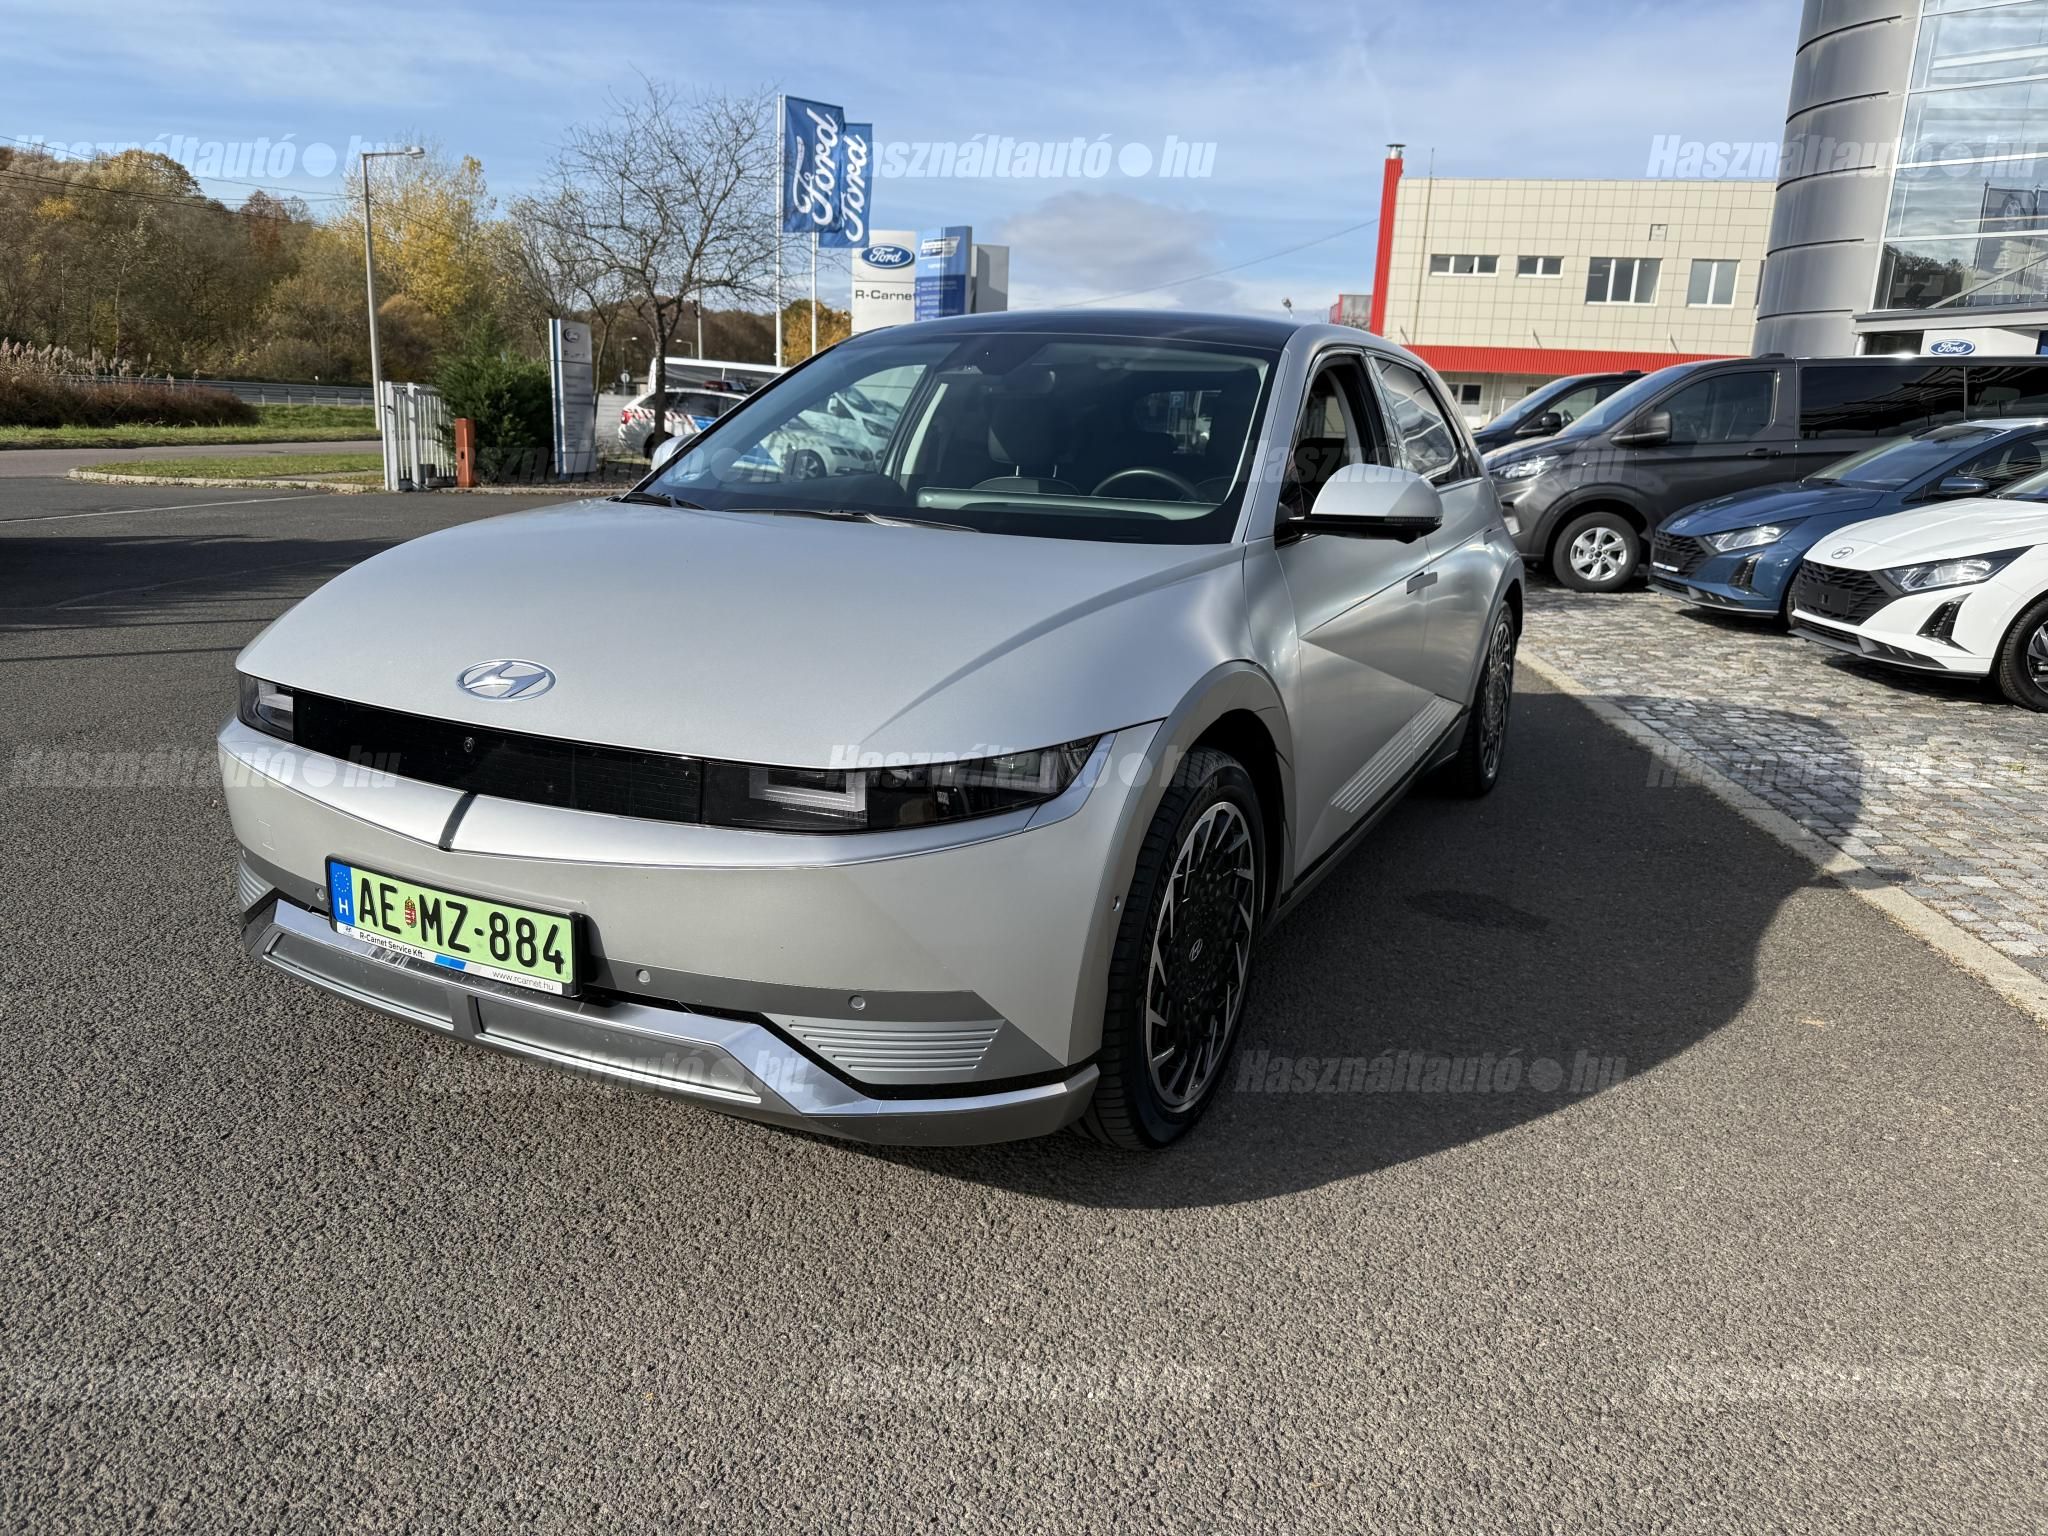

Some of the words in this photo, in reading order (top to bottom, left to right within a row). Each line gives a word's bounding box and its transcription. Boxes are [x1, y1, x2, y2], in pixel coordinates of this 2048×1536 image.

[793, 107, 839, 226] Ford
[868, 246, 902, 264] Ford
[1937, 340, 1966, 353] Ford
[338, 897, 350, 916] H
[359, 877, 402, 935] AE
[418, 894, 565, 975] MZ-884
[359, 931, 388, 948] R-Carnet
[388, 940, 412, 955] Service
[412, 949, 425, 959] Kft.
[492, 971, 555, 991] www.rcarnet.hu
